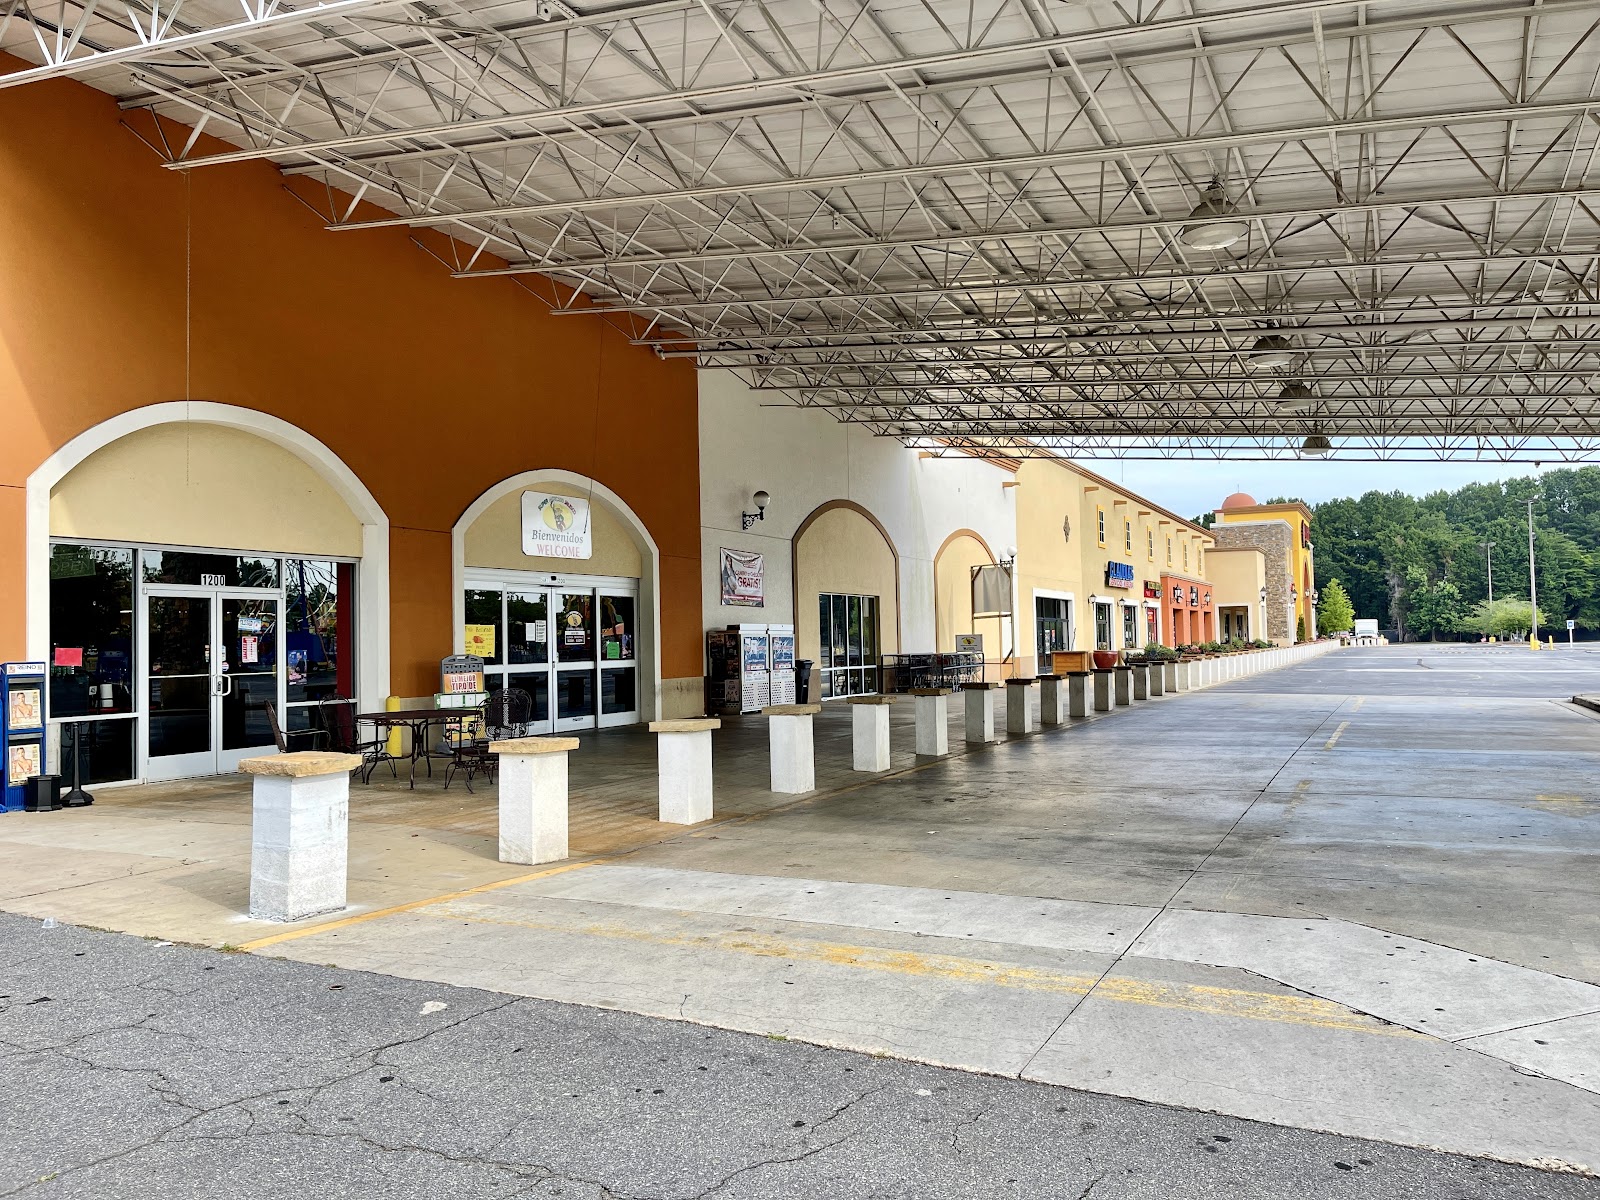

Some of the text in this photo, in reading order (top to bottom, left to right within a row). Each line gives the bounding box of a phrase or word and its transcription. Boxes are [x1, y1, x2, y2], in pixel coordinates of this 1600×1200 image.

[531, 529, 584, 544] Bienvenidos
[536, 543, 580, 557] WELCOME
[203, 575, 225, 587] 1200
[738, 577, 760, 589] GRATIS!
[457, 674, 476, 682] MEJOR
[451, 682, 466, 691] TIPO
[467, 681, 476, 690] DE
